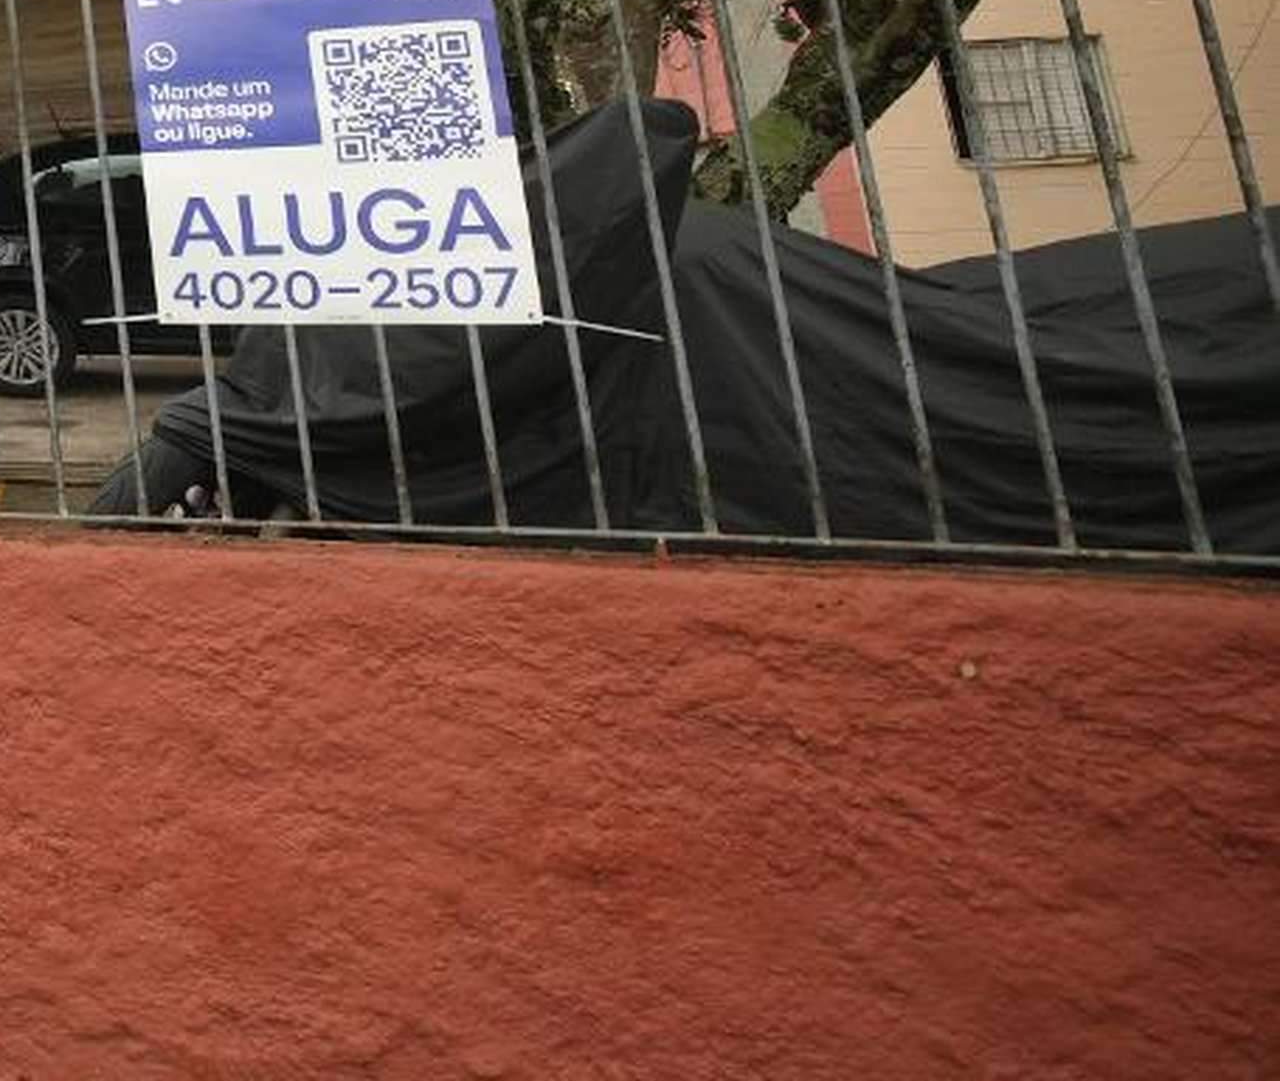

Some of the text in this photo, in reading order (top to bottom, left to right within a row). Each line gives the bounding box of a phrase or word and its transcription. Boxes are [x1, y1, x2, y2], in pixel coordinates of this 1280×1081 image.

[147, 80, 271, 101] Mande um
[150, 102, 275, 122] Whatsapp
[154, 122, 254, 145] ou ligue.
[170, 187, 513, 257] ALUGA
[173, 267, 519, 311] 4020-2507
